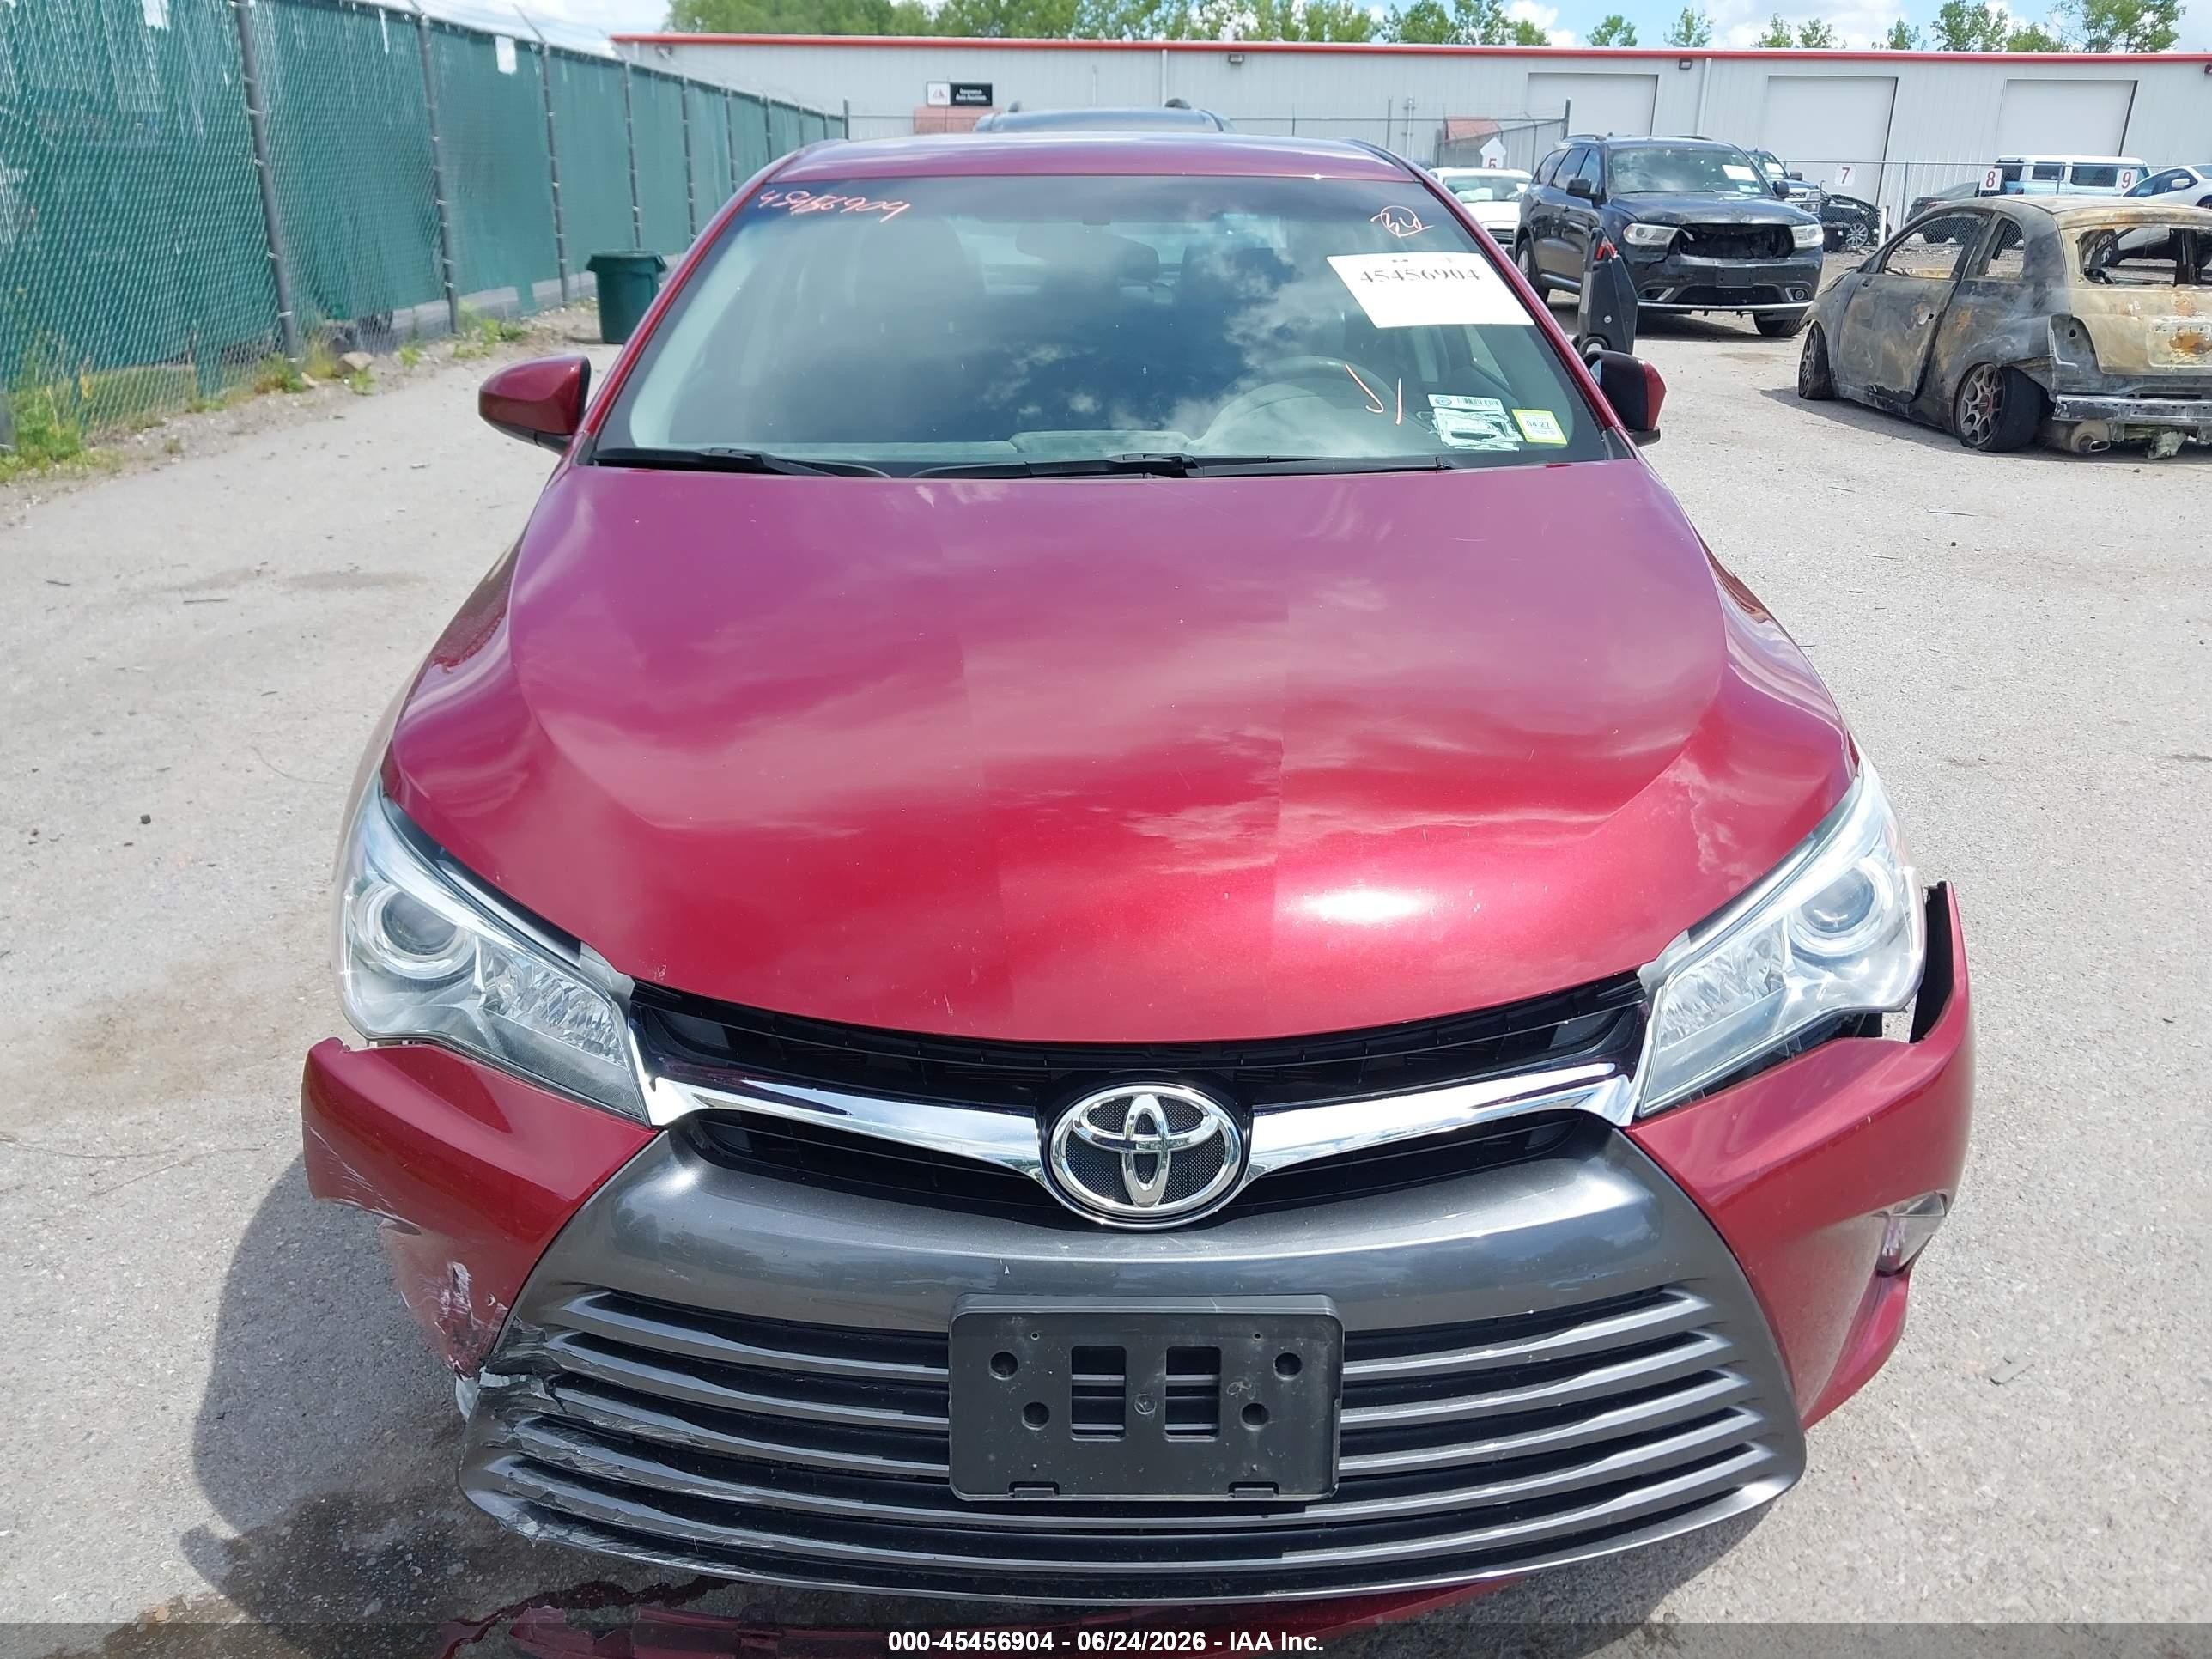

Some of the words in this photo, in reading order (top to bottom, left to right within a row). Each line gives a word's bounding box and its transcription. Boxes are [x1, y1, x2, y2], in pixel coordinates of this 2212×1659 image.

[1842, 167, 1850, 184] 7
[1985, 171, 1996, 188] 8
[2122, 171, 2131, 188] 9
[1360, 268, 1480, 283] 45456904
